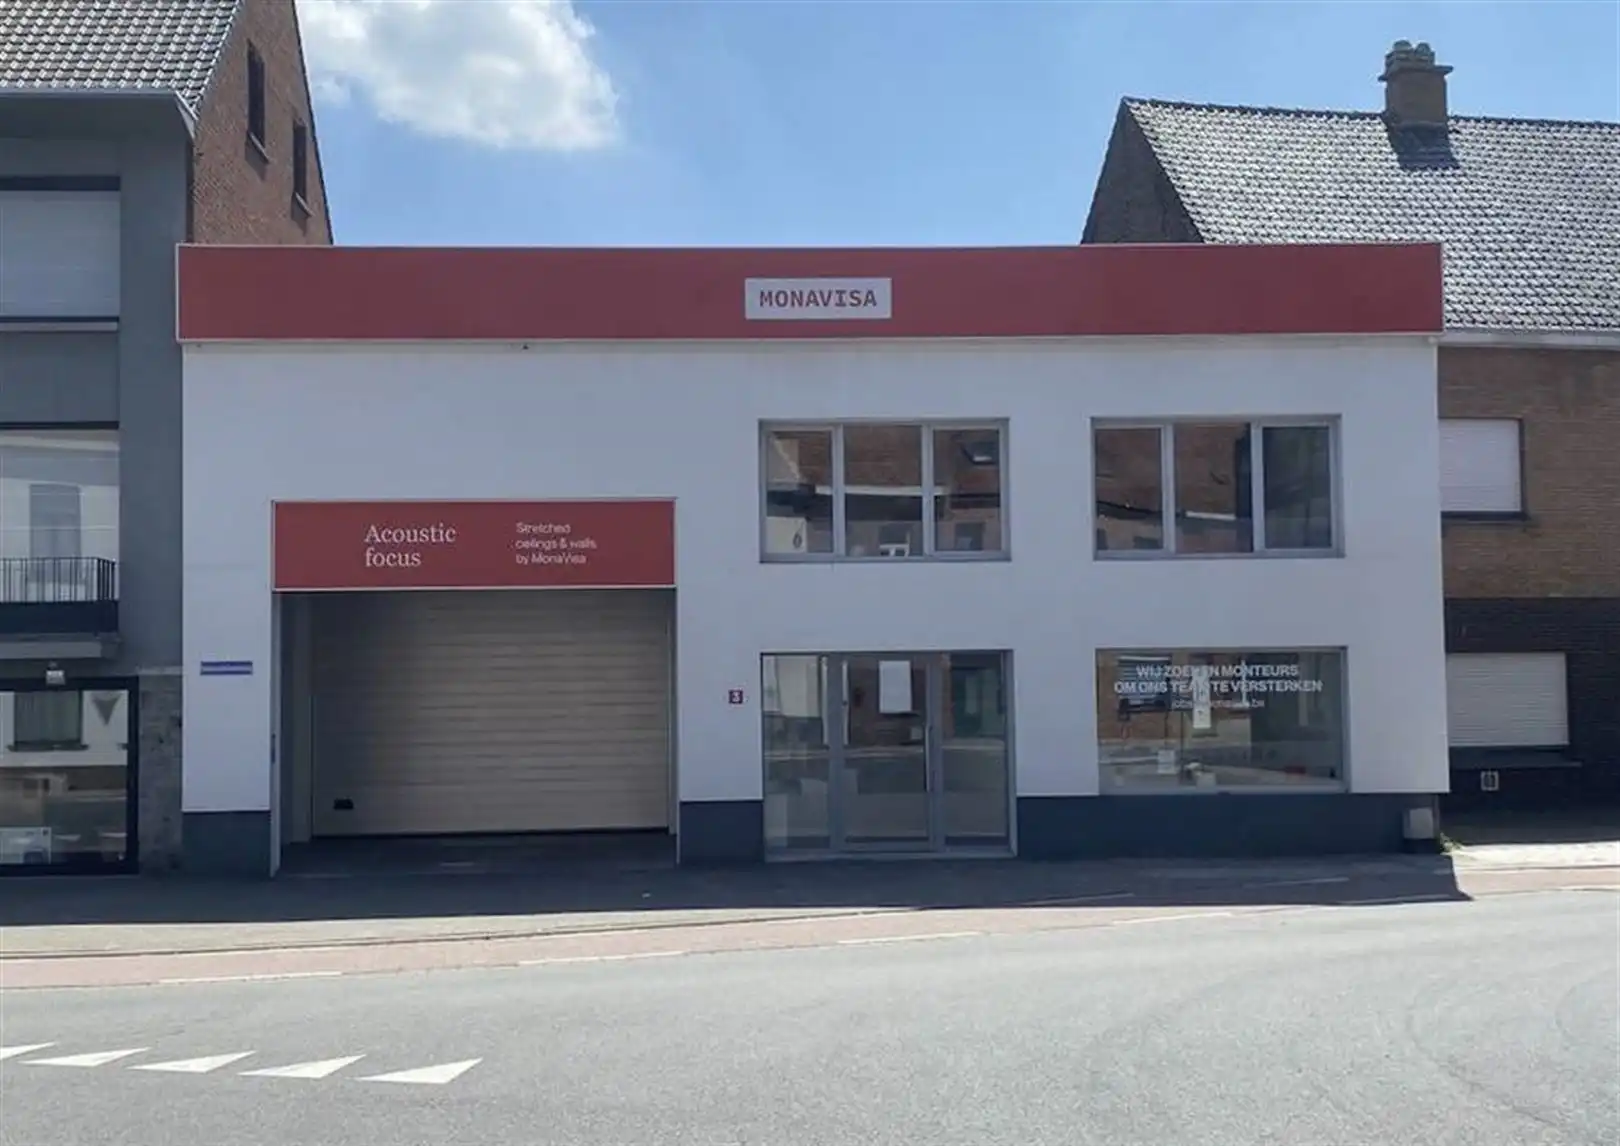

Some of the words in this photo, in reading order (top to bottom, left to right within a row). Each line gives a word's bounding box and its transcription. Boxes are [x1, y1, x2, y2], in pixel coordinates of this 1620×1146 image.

[759, 288, 878, 308] MONAVISA
[364, 522, 456, 543] Acoustic
[515, 522, 571, 534] Stretched
[515, 538, 557, 550] ceilings
[559, 538, 568, 549] &
[569, 538, 597, 549] walls
[365, 546, 422, 567] focus
[515, 553, 529, 565] by
[1135, 664, 1162, 677] WIJ
[1221, 664, 1299, 677] MONTEURS
[1114, 681, 1137, 694] OM
[1138, 681, 1168, 694] ONS
[1170, 681, 1209, 694] TEA
[1210, 681, 1228, 693] TE
[1229, 680, 1323, 693] VERSTERKEN
